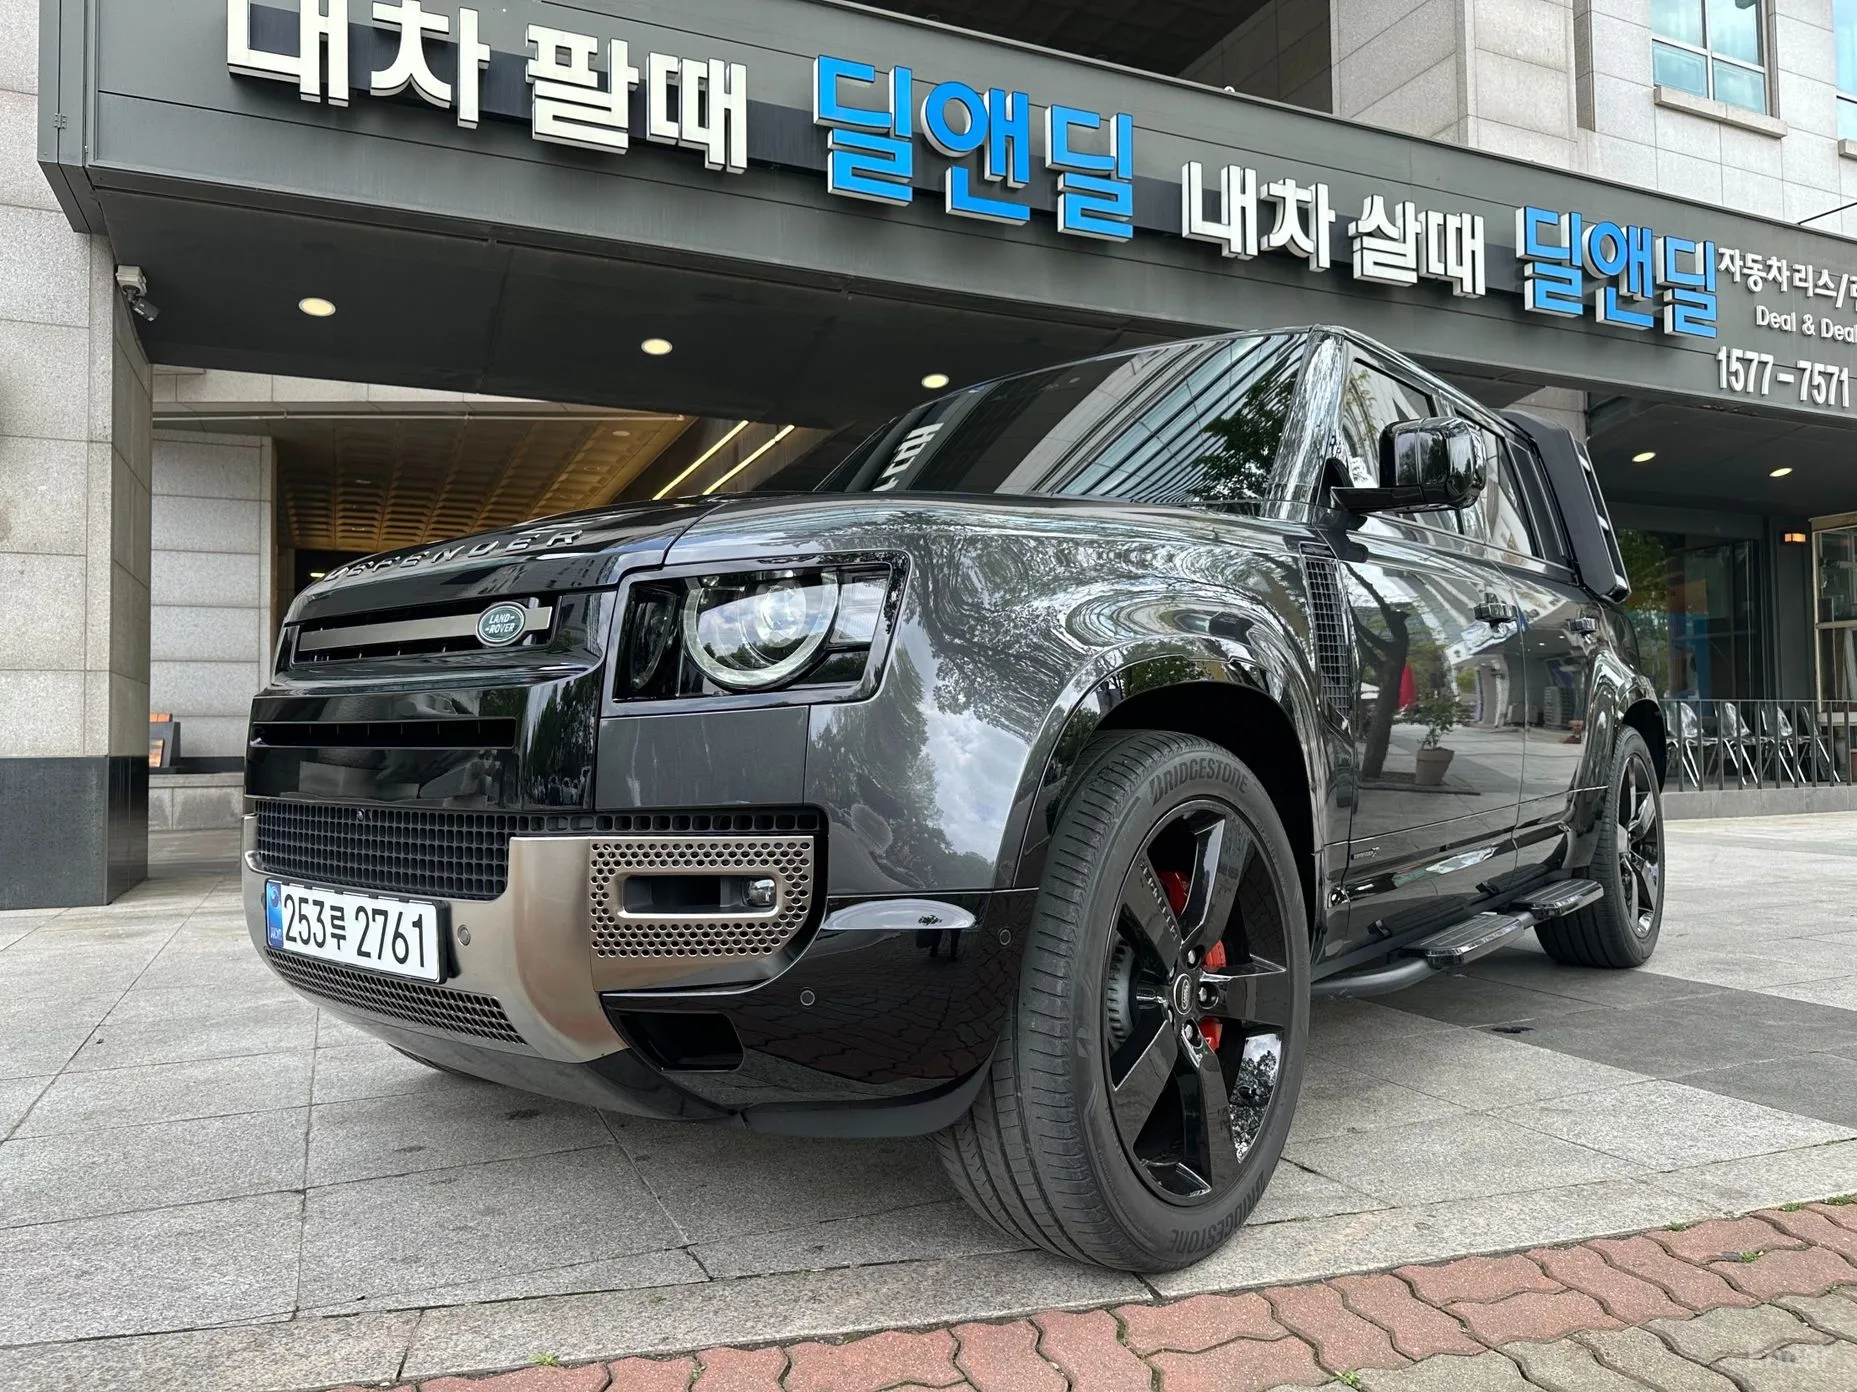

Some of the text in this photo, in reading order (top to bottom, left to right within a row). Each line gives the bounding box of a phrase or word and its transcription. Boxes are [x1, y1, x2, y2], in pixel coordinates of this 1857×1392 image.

[227, 0, 1717, 340] 내차 팔때 딜앤딜 내차 살때 딜앤딜
[1756, 304, 1857, 345] Deal & Deal
[1716, 345, 1850, 409] 1577-7571
[1148, 757, 1249, 808] BRIDGESTONE
[283, 893, 426, 969] 253루 2761
